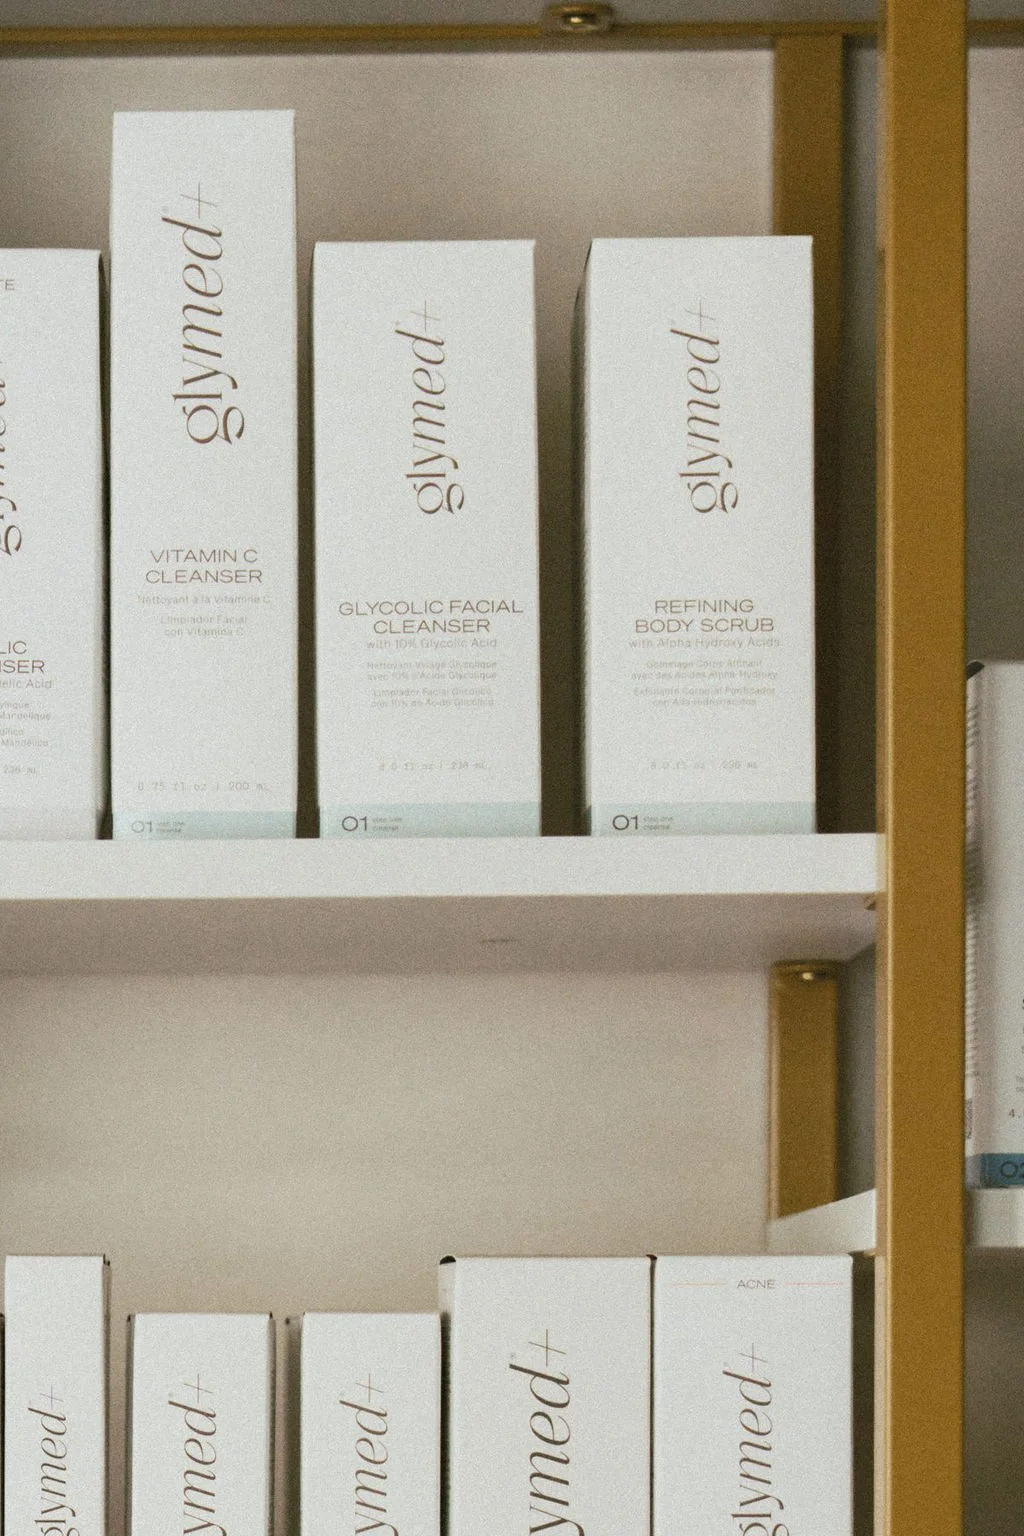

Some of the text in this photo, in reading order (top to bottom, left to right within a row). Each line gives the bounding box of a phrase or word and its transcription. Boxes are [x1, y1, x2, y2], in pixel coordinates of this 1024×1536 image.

[150, 549, 259, 564] VITAMIN C
[145, 569, 263, 584] CLEANSER
[338, 599, 524, 616] GLYCOLIC FACIAL
[654, 599, 755, 614] REFINING
[372, 619, 491, 635] CLEANSER
[635, 618, 775, 634] BODY SCRUB
[131, 820, 154, 833] 01
[342, 815, 367, 831] 01
[612, 814, 638, 831] 01
[736, 1279, 776, 1290] ACNE
